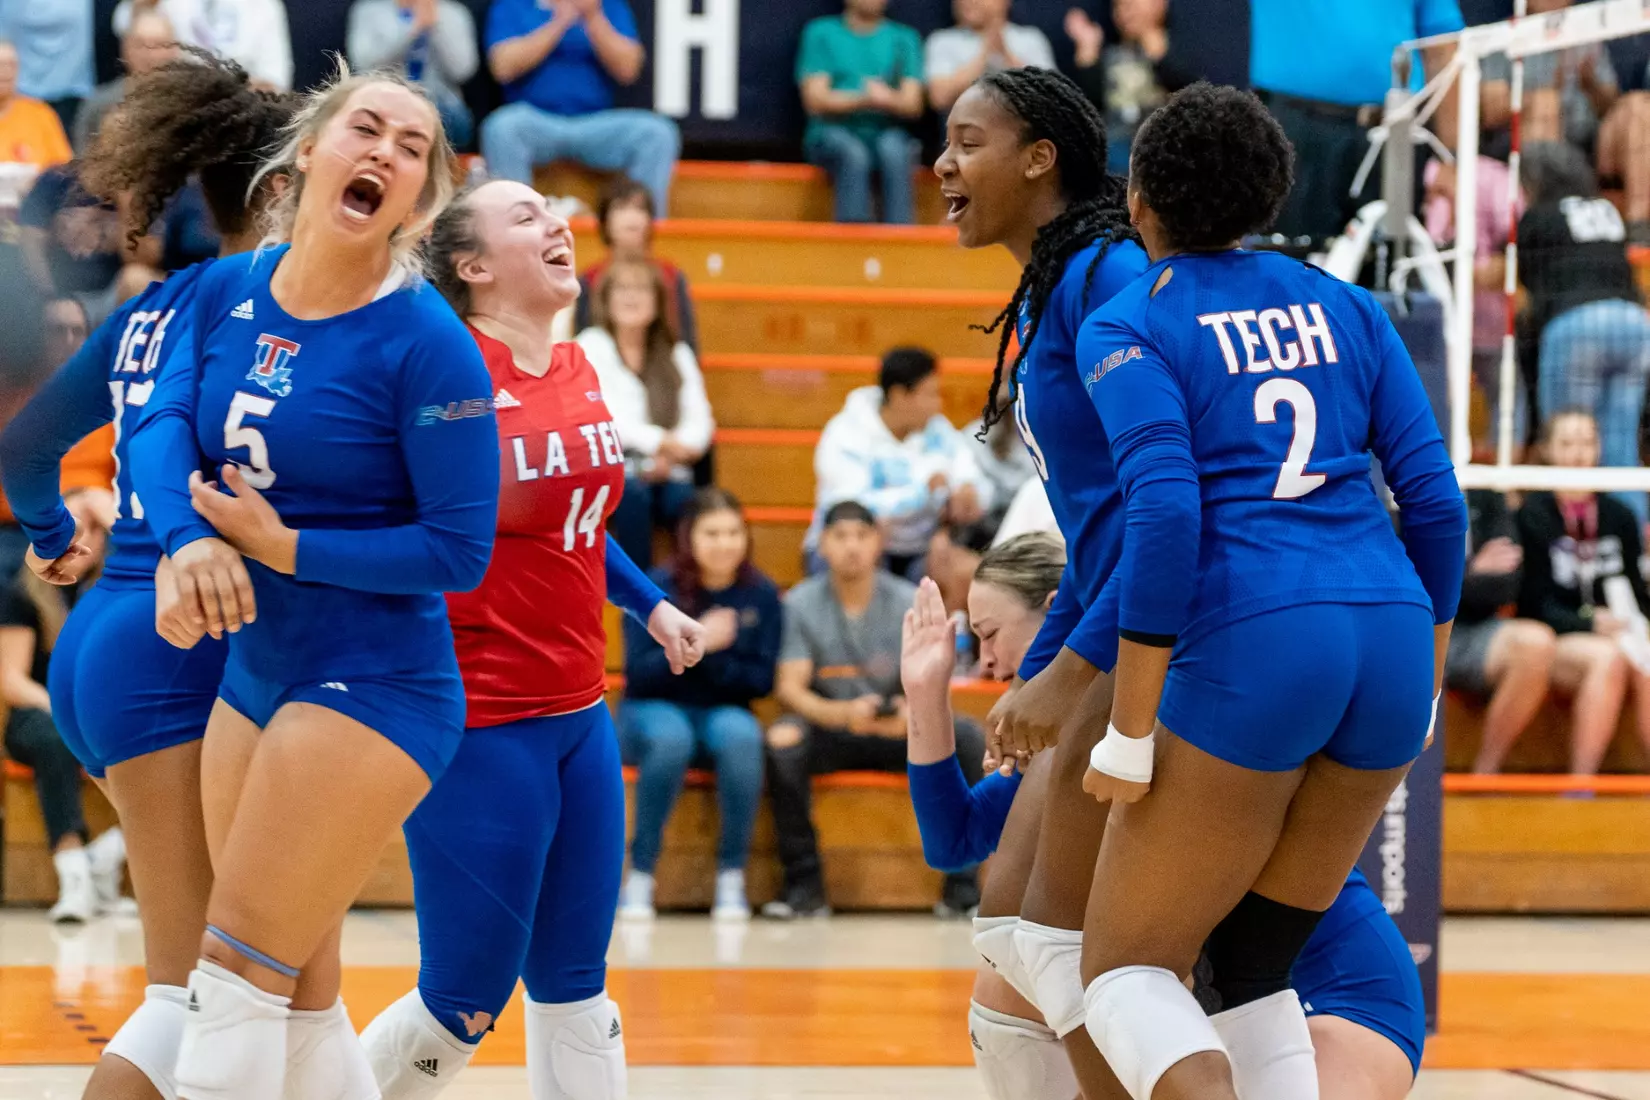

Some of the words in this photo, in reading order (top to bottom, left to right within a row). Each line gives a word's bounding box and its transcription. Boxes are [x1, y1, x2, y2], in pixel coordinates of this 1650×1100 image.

[114, 309, 175, 374] TE
[1196, 303, 1339, 375] TECH
[223, 390, 278, 489] 5
[512, 431, 570, 482] LA
[1253, 377, 1328, 499] 2
[563, 484, 610, 552] 14
